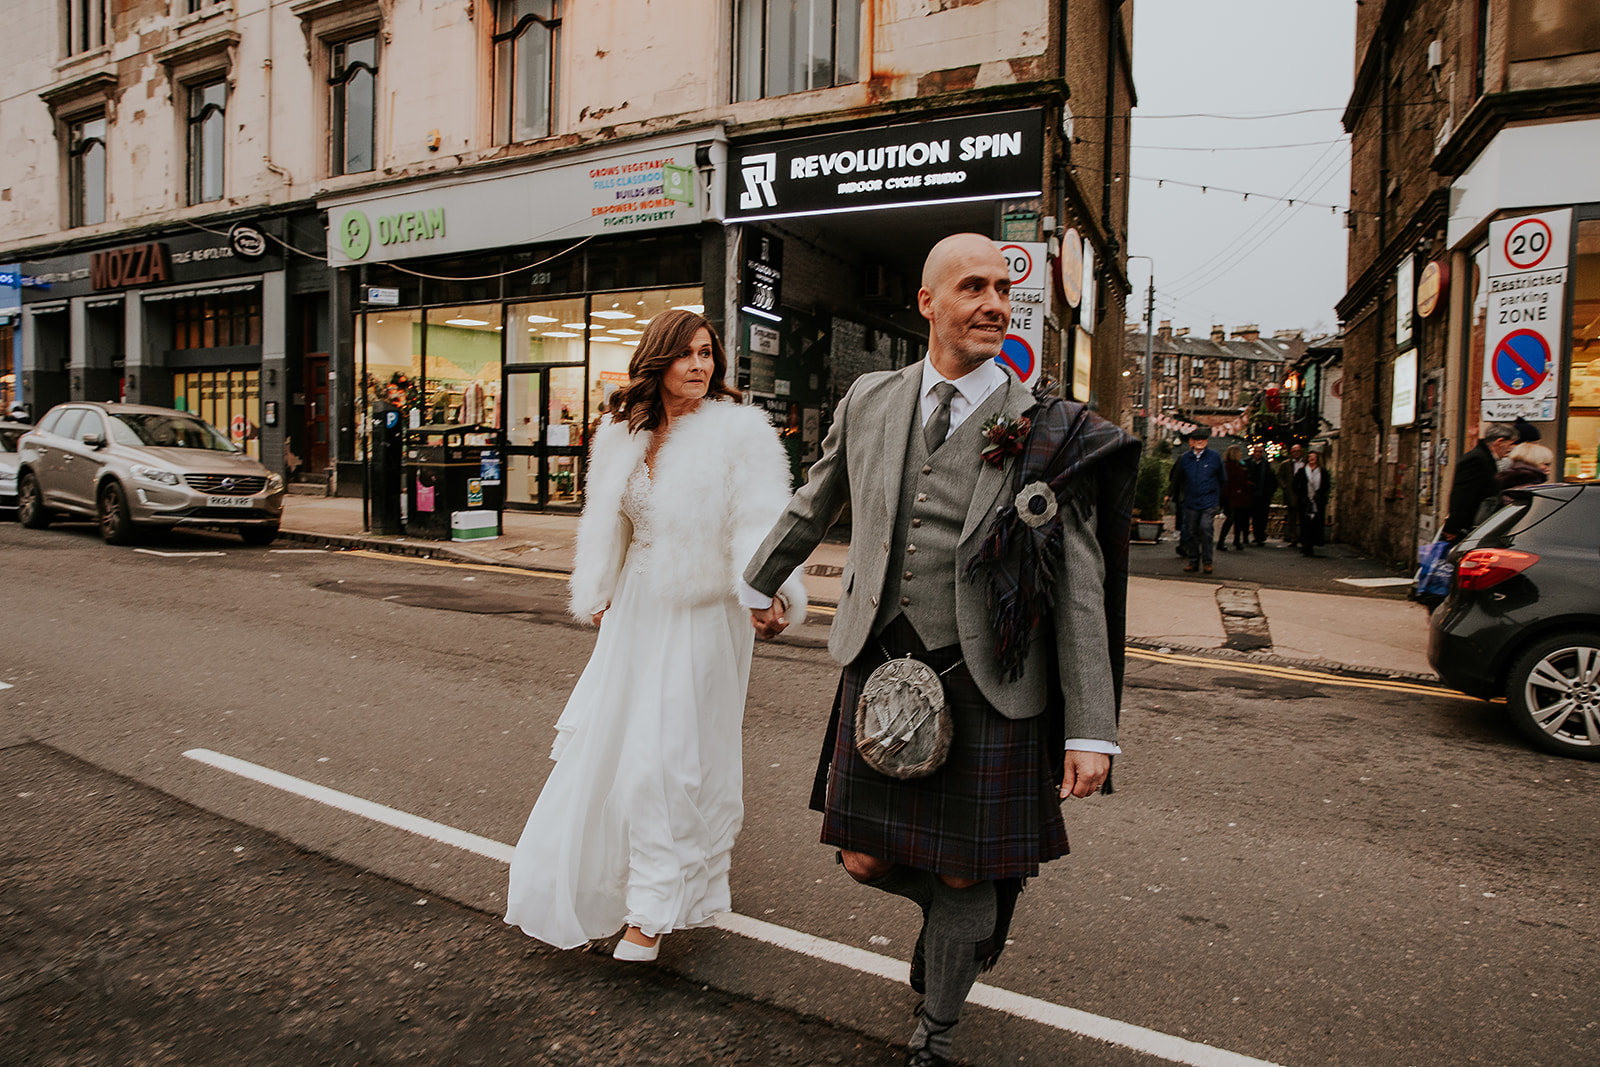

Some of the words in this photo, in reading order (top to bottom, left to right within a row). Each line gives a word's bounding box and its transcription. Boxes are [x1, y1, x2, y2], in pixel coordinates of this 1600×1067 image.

[789, 140, 950, 179] REVOLUTION
[959, 131, 1022, 162] SPIN
[589, 165, 620, 178] GROWS
[593, 178, 615, 190] FILLS
[616, 171, 664, 187] CLASSROO
[837, 179, 883, 194] INDOOR
[885, 175, 922, 190] CYCLE
[923, 170, 968, 186] STUDIO
[616, 187, 645, 200] BUILDS
[591, 202, 638, 216] EMPOWERS
[640, 197, 675, 210] WOMEN
[377, 207, 446, 246] OXFAM
[603, 215, 634, 226] FIGHTS
[636, 210, 675, 223] POVERTY
[1511, 232, 1546, 256] 20
[90, 242, 168, 290] MOZZA
[531, 272, 551, 285] 231
[1491, 272, 1563, 291] Restricted
[1499, 291, 1549, 308] parking
[1499, 306, 1547, 325] ZONE
[386, 412, 396, 426] P
